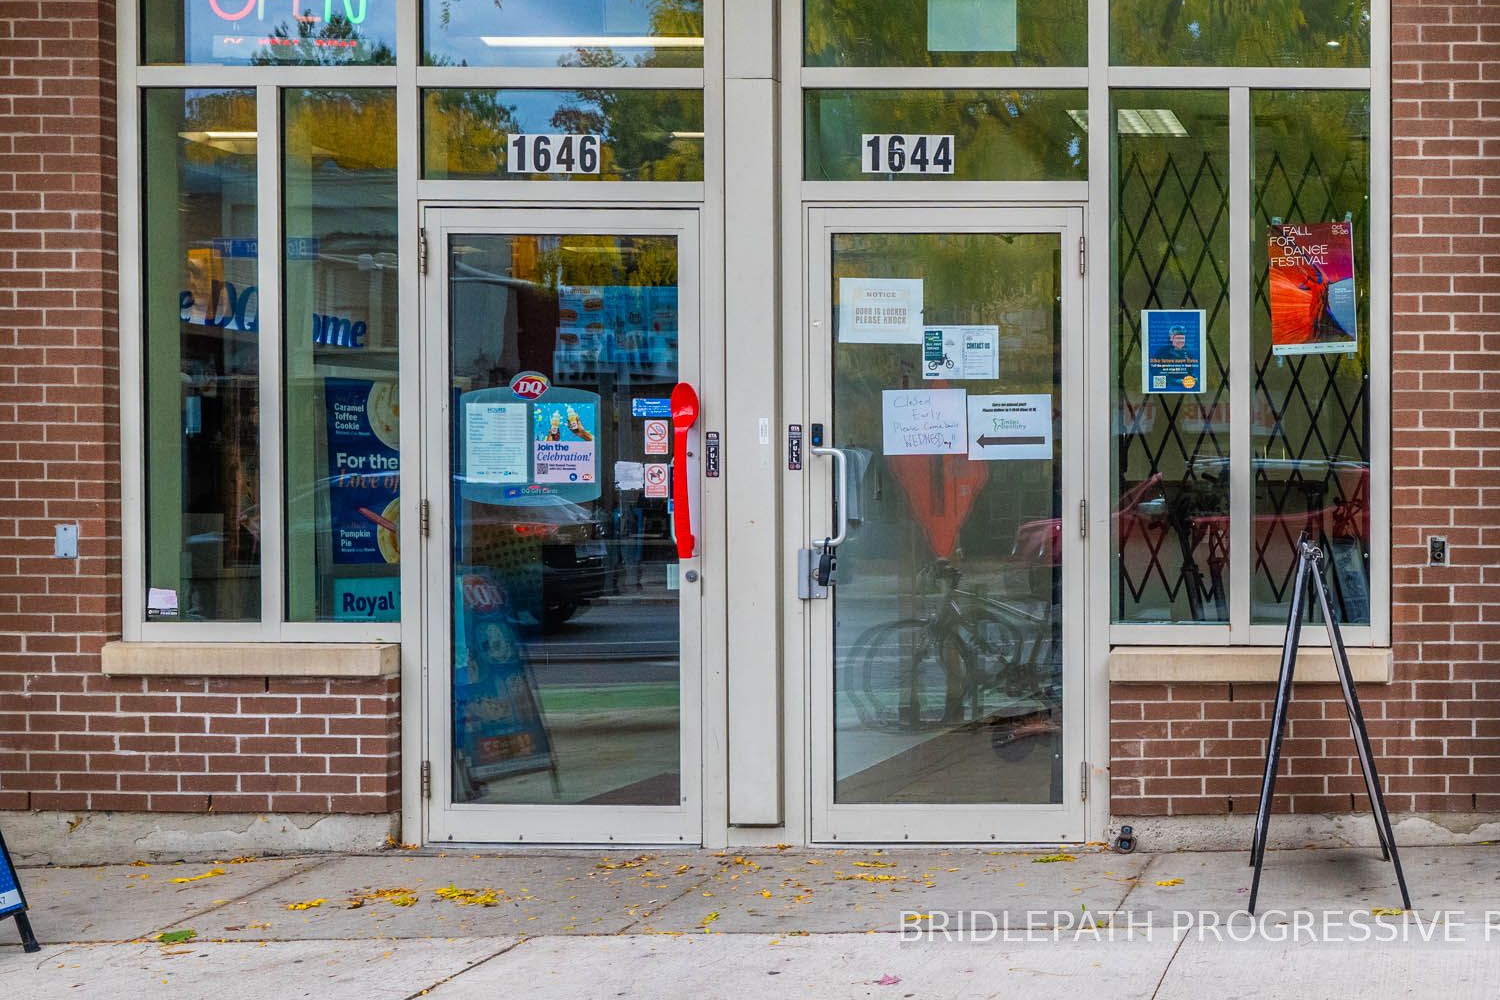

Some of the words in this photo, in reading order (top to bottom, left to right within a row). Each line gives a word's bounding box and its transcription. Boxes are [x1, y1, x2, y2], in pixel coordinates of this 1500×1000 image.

[512, 135, 597, 172] 1646
[866, 135, 953, 172] 1644
[1283, 226, 1312, 236] FALL
[1269, 236, 1295, 246] FOR
[1284, 245, 1328, 256] DANCE
[1270, 256, 1328, 266] FESTIVAL
[518, 381, 543, 395] DQ
[334, 403, 364, 412] Caramel
[334, 412, 358, 421] Toffee
[335, 422, 360, 430] Cookie
[537, 443, 554, 451] Join
[555, 443, 569, 451] the
[336, 453, 366, 469] For
[369, 454, 398, 470] the
[536, 452, 592, 462] Celebration!
[340, 529, 371, 539] Pumpkin
[341, 539, 352, 547] Pie
[342, 590, 395, 617] Royal
